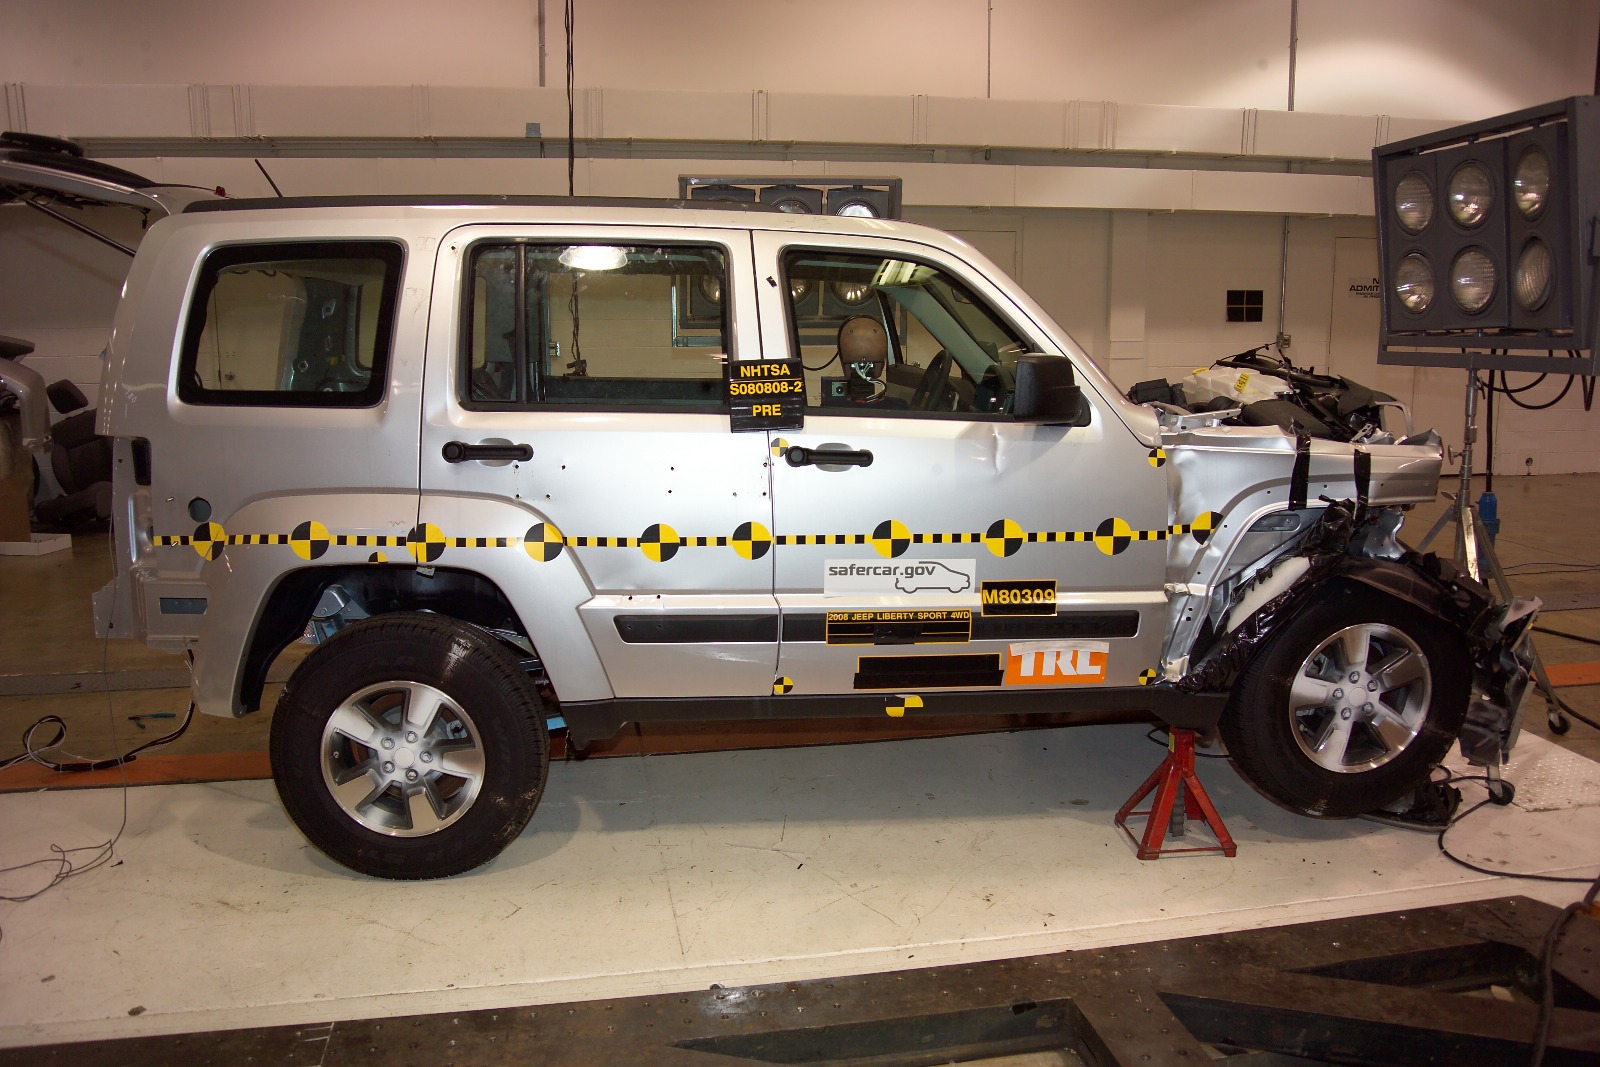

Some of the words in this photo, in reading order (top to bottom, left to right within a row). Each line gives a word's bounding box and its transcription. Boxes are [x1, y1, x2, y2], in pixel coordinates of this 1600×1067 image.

[740, 363, 791, 378] NHTSA
[729, 381, 803, 396] S080808-2
[752, 404, 782, 417] PRE
[828, 563, 936, 578] safercar.gov
[982, 588, 1056, 605] M80309
[828, 613, 849, 621] 2008
[851, 612, 874, 621] JEEP
[877, 612, 914, 620] LIBERTY
[917, 611, 947, 620] SPORT
[950, 611, 970, 619] 4WD
